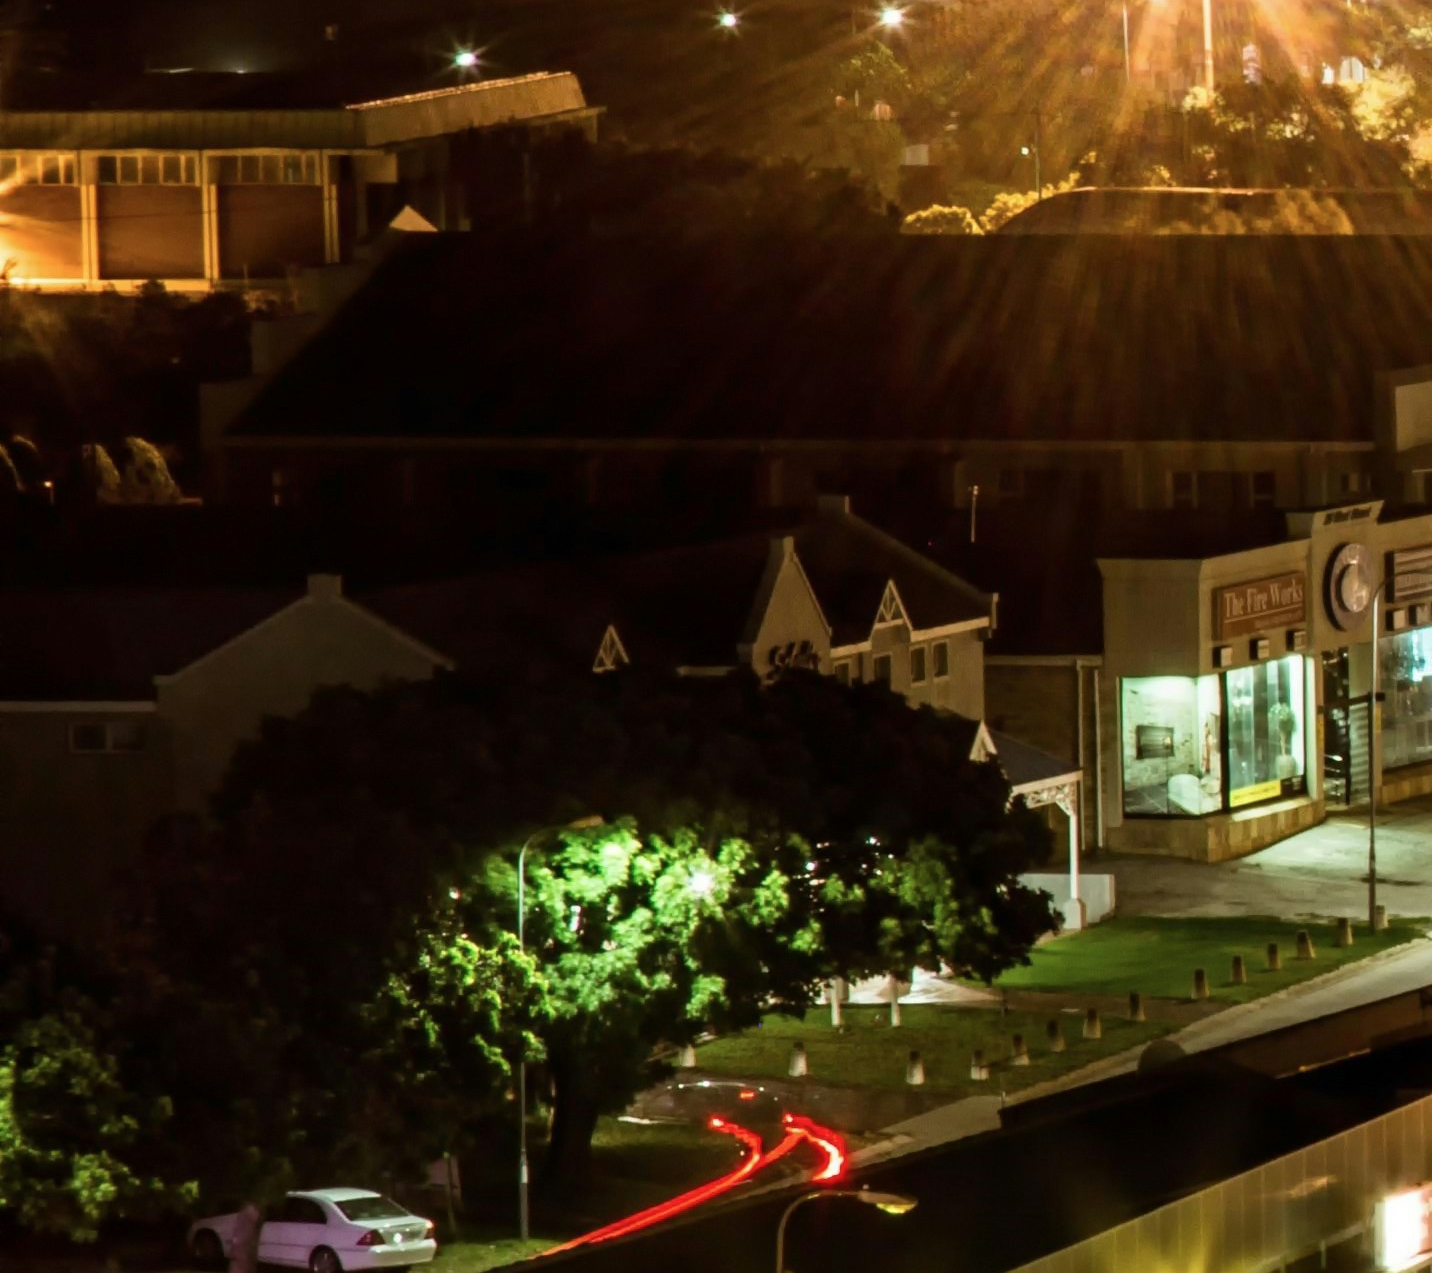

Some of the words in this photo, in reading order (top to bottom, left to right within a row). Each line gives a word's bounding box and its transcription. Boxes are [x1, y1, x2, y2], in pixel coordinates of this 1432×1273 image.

[1224, 589, 1244, 619] The
[1246, 582, 1267, 613] Fire
[1269, 576, 1304, 608] Works
